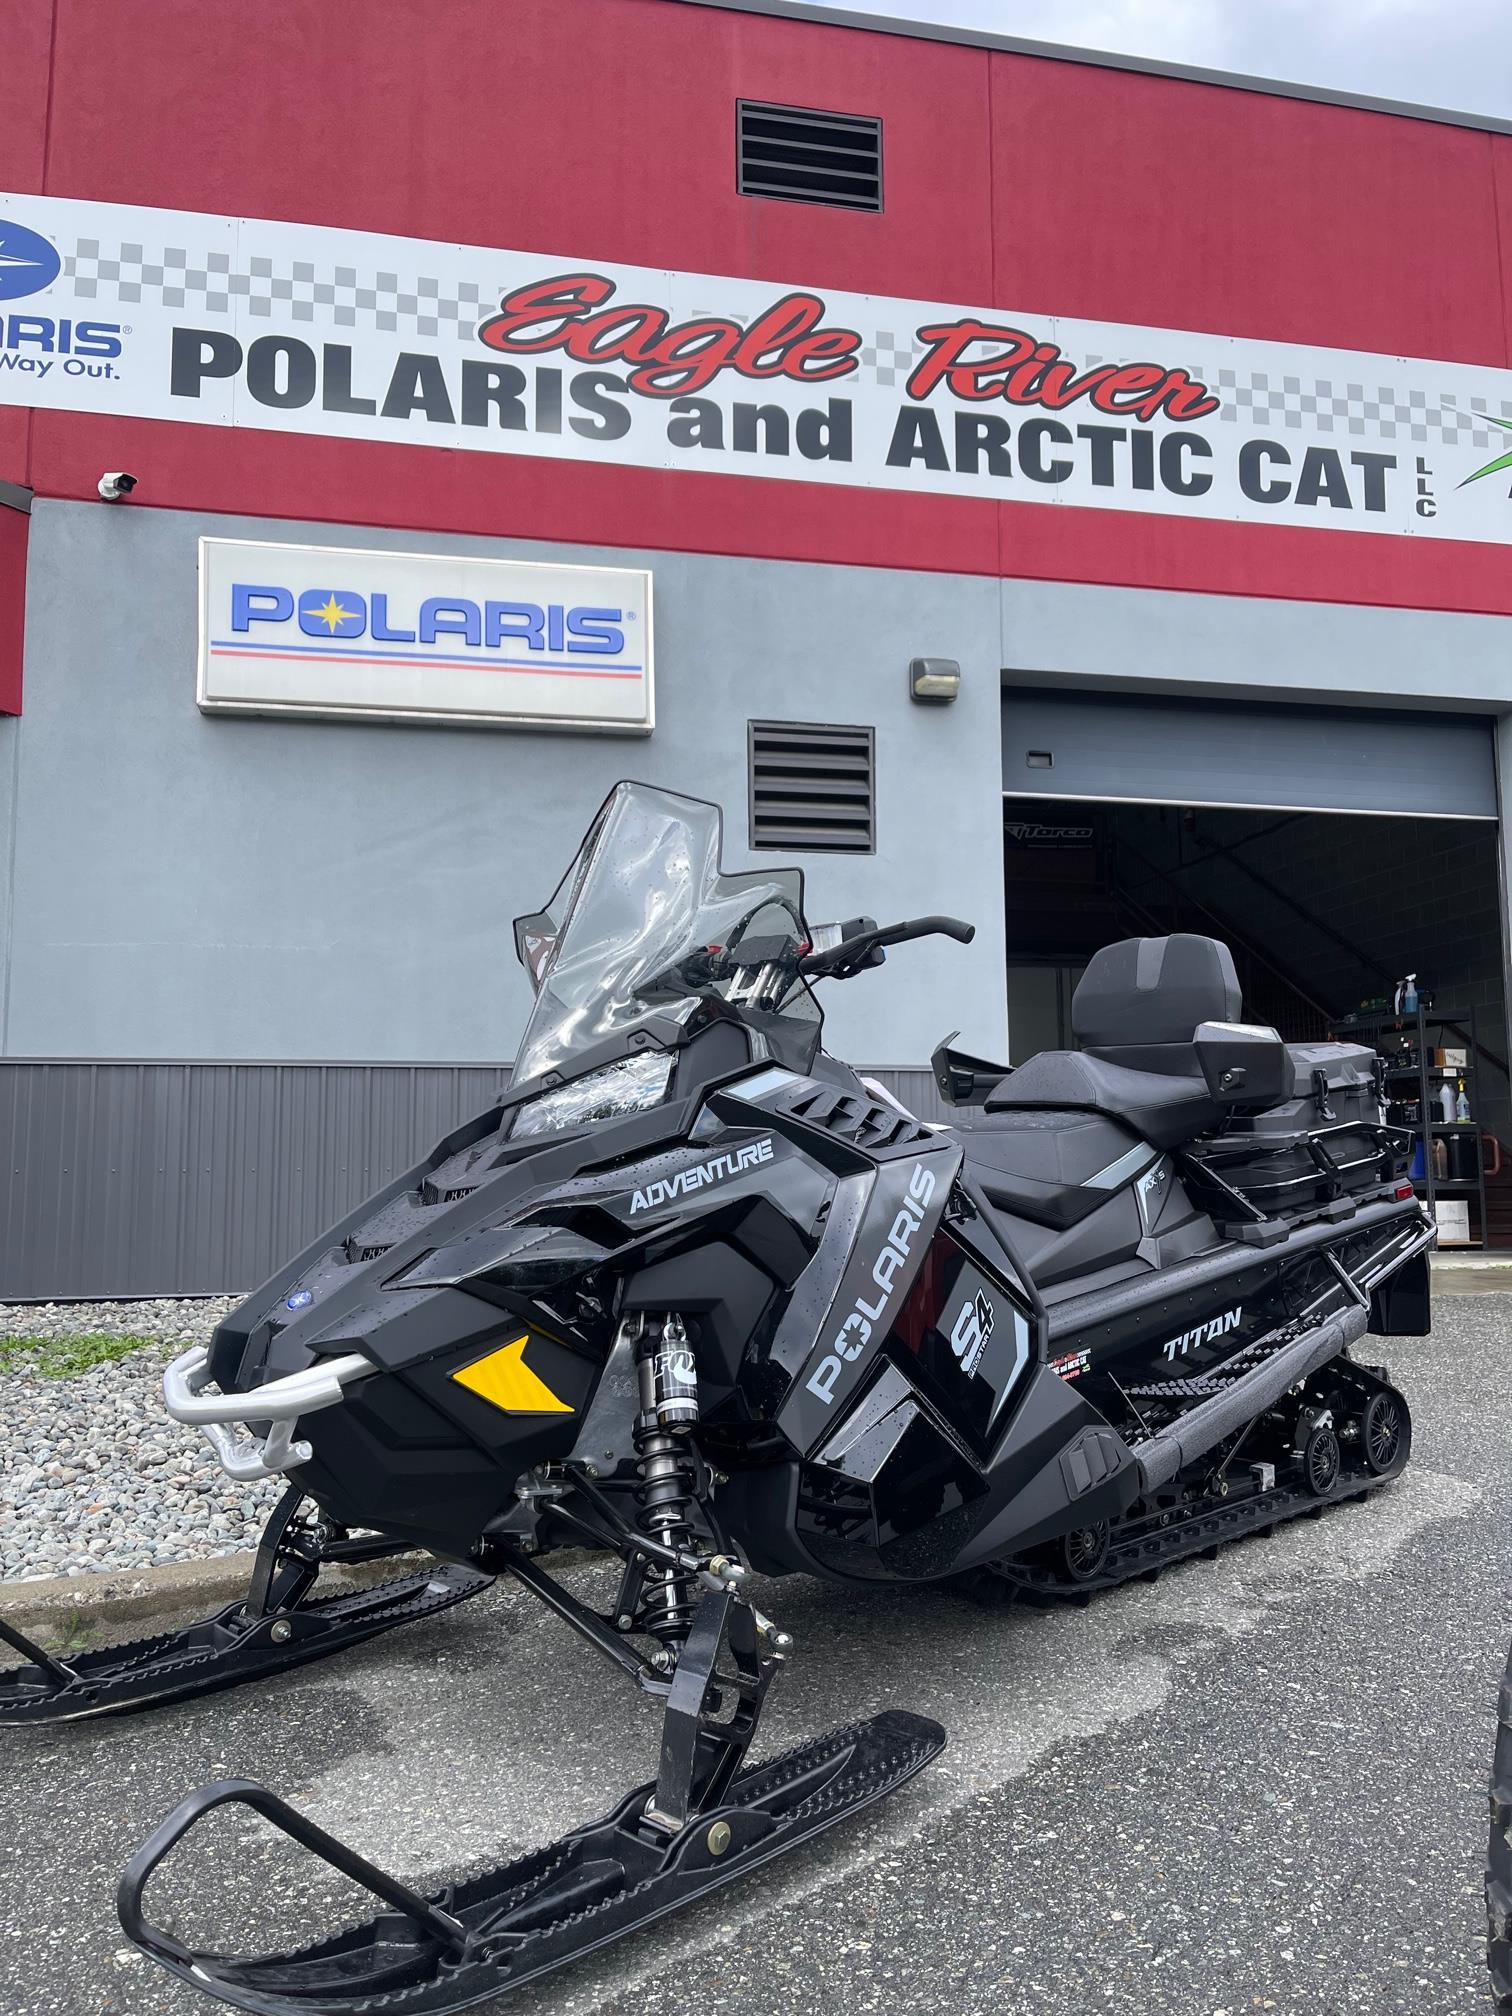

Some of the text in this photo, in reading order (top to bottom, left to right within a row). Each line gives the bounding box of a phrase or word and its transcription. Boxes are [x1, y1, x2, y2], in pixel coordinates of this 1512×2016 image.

[63, 359, 120, 380] Out.
[478, 273, 1221, 423] Eagle River
[170, 326, 1398, 513] POLARIS and ARCTIC CAT
[1416, 456, 1437, 518] LLC
[629, 1138, 774, 1214] ADVENTURE
[805, 1163, 936, 1405] POLARIS
[1163, 1306, 1242, 1362] TITAN
